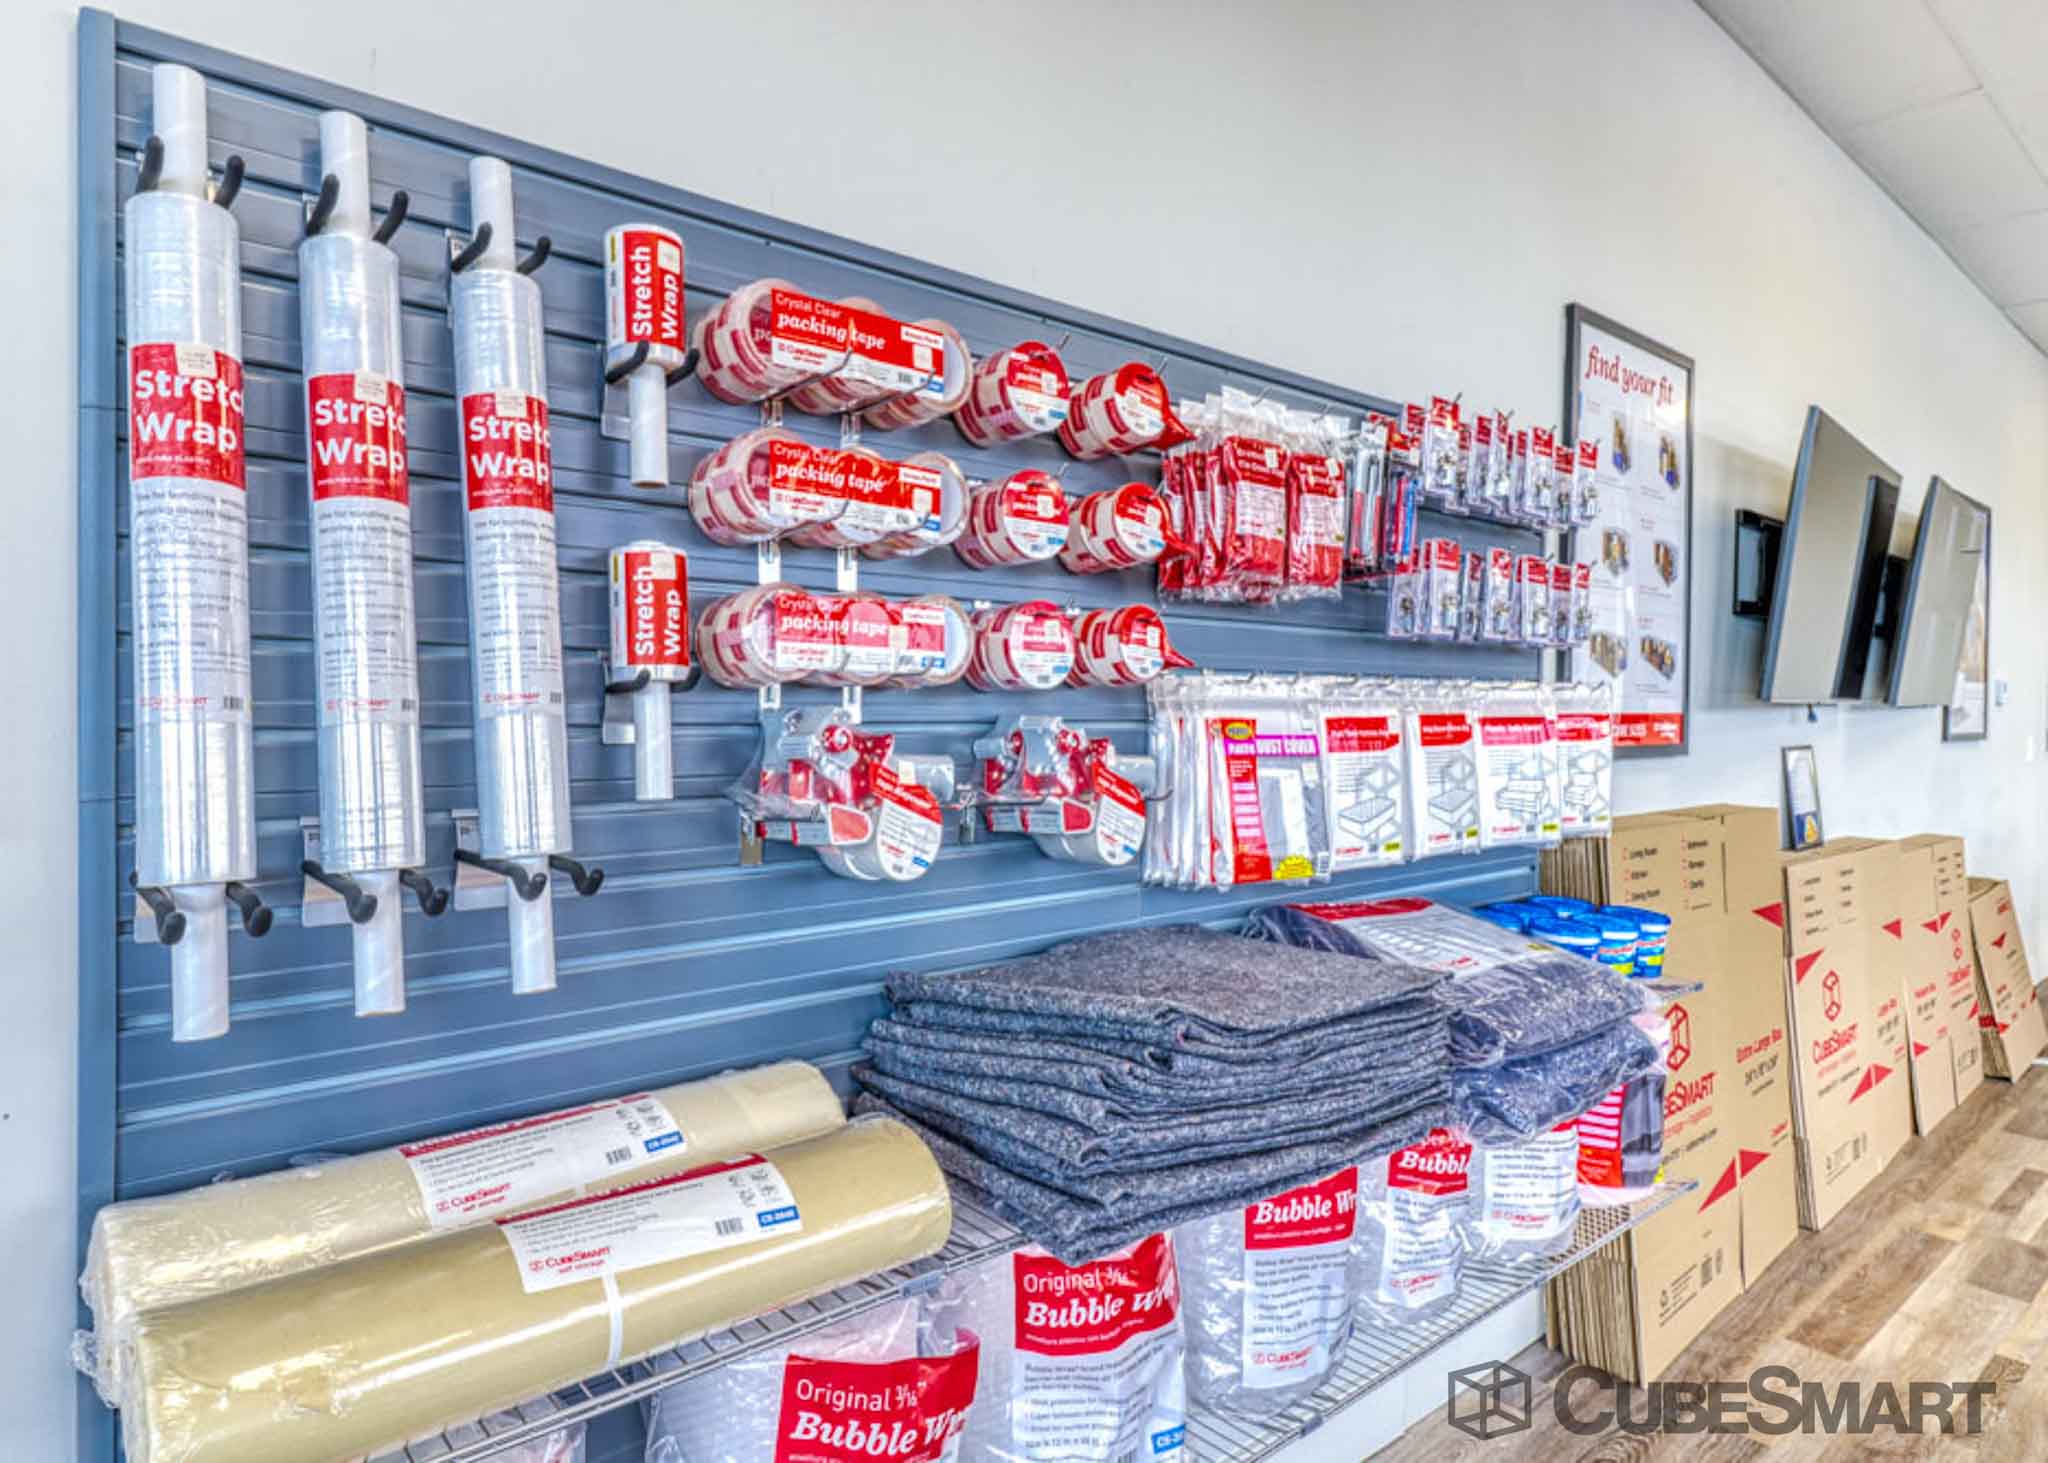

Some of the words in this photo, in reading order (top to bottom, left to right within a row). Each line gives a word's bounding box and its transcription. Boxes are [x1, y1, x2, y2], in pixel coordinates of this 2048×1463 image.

[630, 245, 654, 337] Stretch
[660, 273, 680, 339] Wrap
[776, 311, 848, 343] packing
[851, 325, 886, 350] tape
[1584, 343, 1620, 384] find
[1621, 366, 1657, 394] your
[135, 411, 238, 455] Wrap
[315, 436, 405, 476] Wrap
[470, 451, 549, 486] Wrap
[775, 462, 846, 489] packing
[847, 472, 887, 494] tape
[631, 563, 656, 656] Stretch
[662, 589, 683, 657] Wrap
[781, 614, 850, 634] packing
[851, 620, 888, 638] tape
[1252, 1194, 1333, 1225] Bubble
[543, 1246, 612, 1268] CUBESMART
[1023, 1267, 1100, 1298] Original
[1024, 1292, 1126, 1330] Bubble
[796, 1378, 891, 1413] Original
[788, 1410, 918, 1457] Bubble
